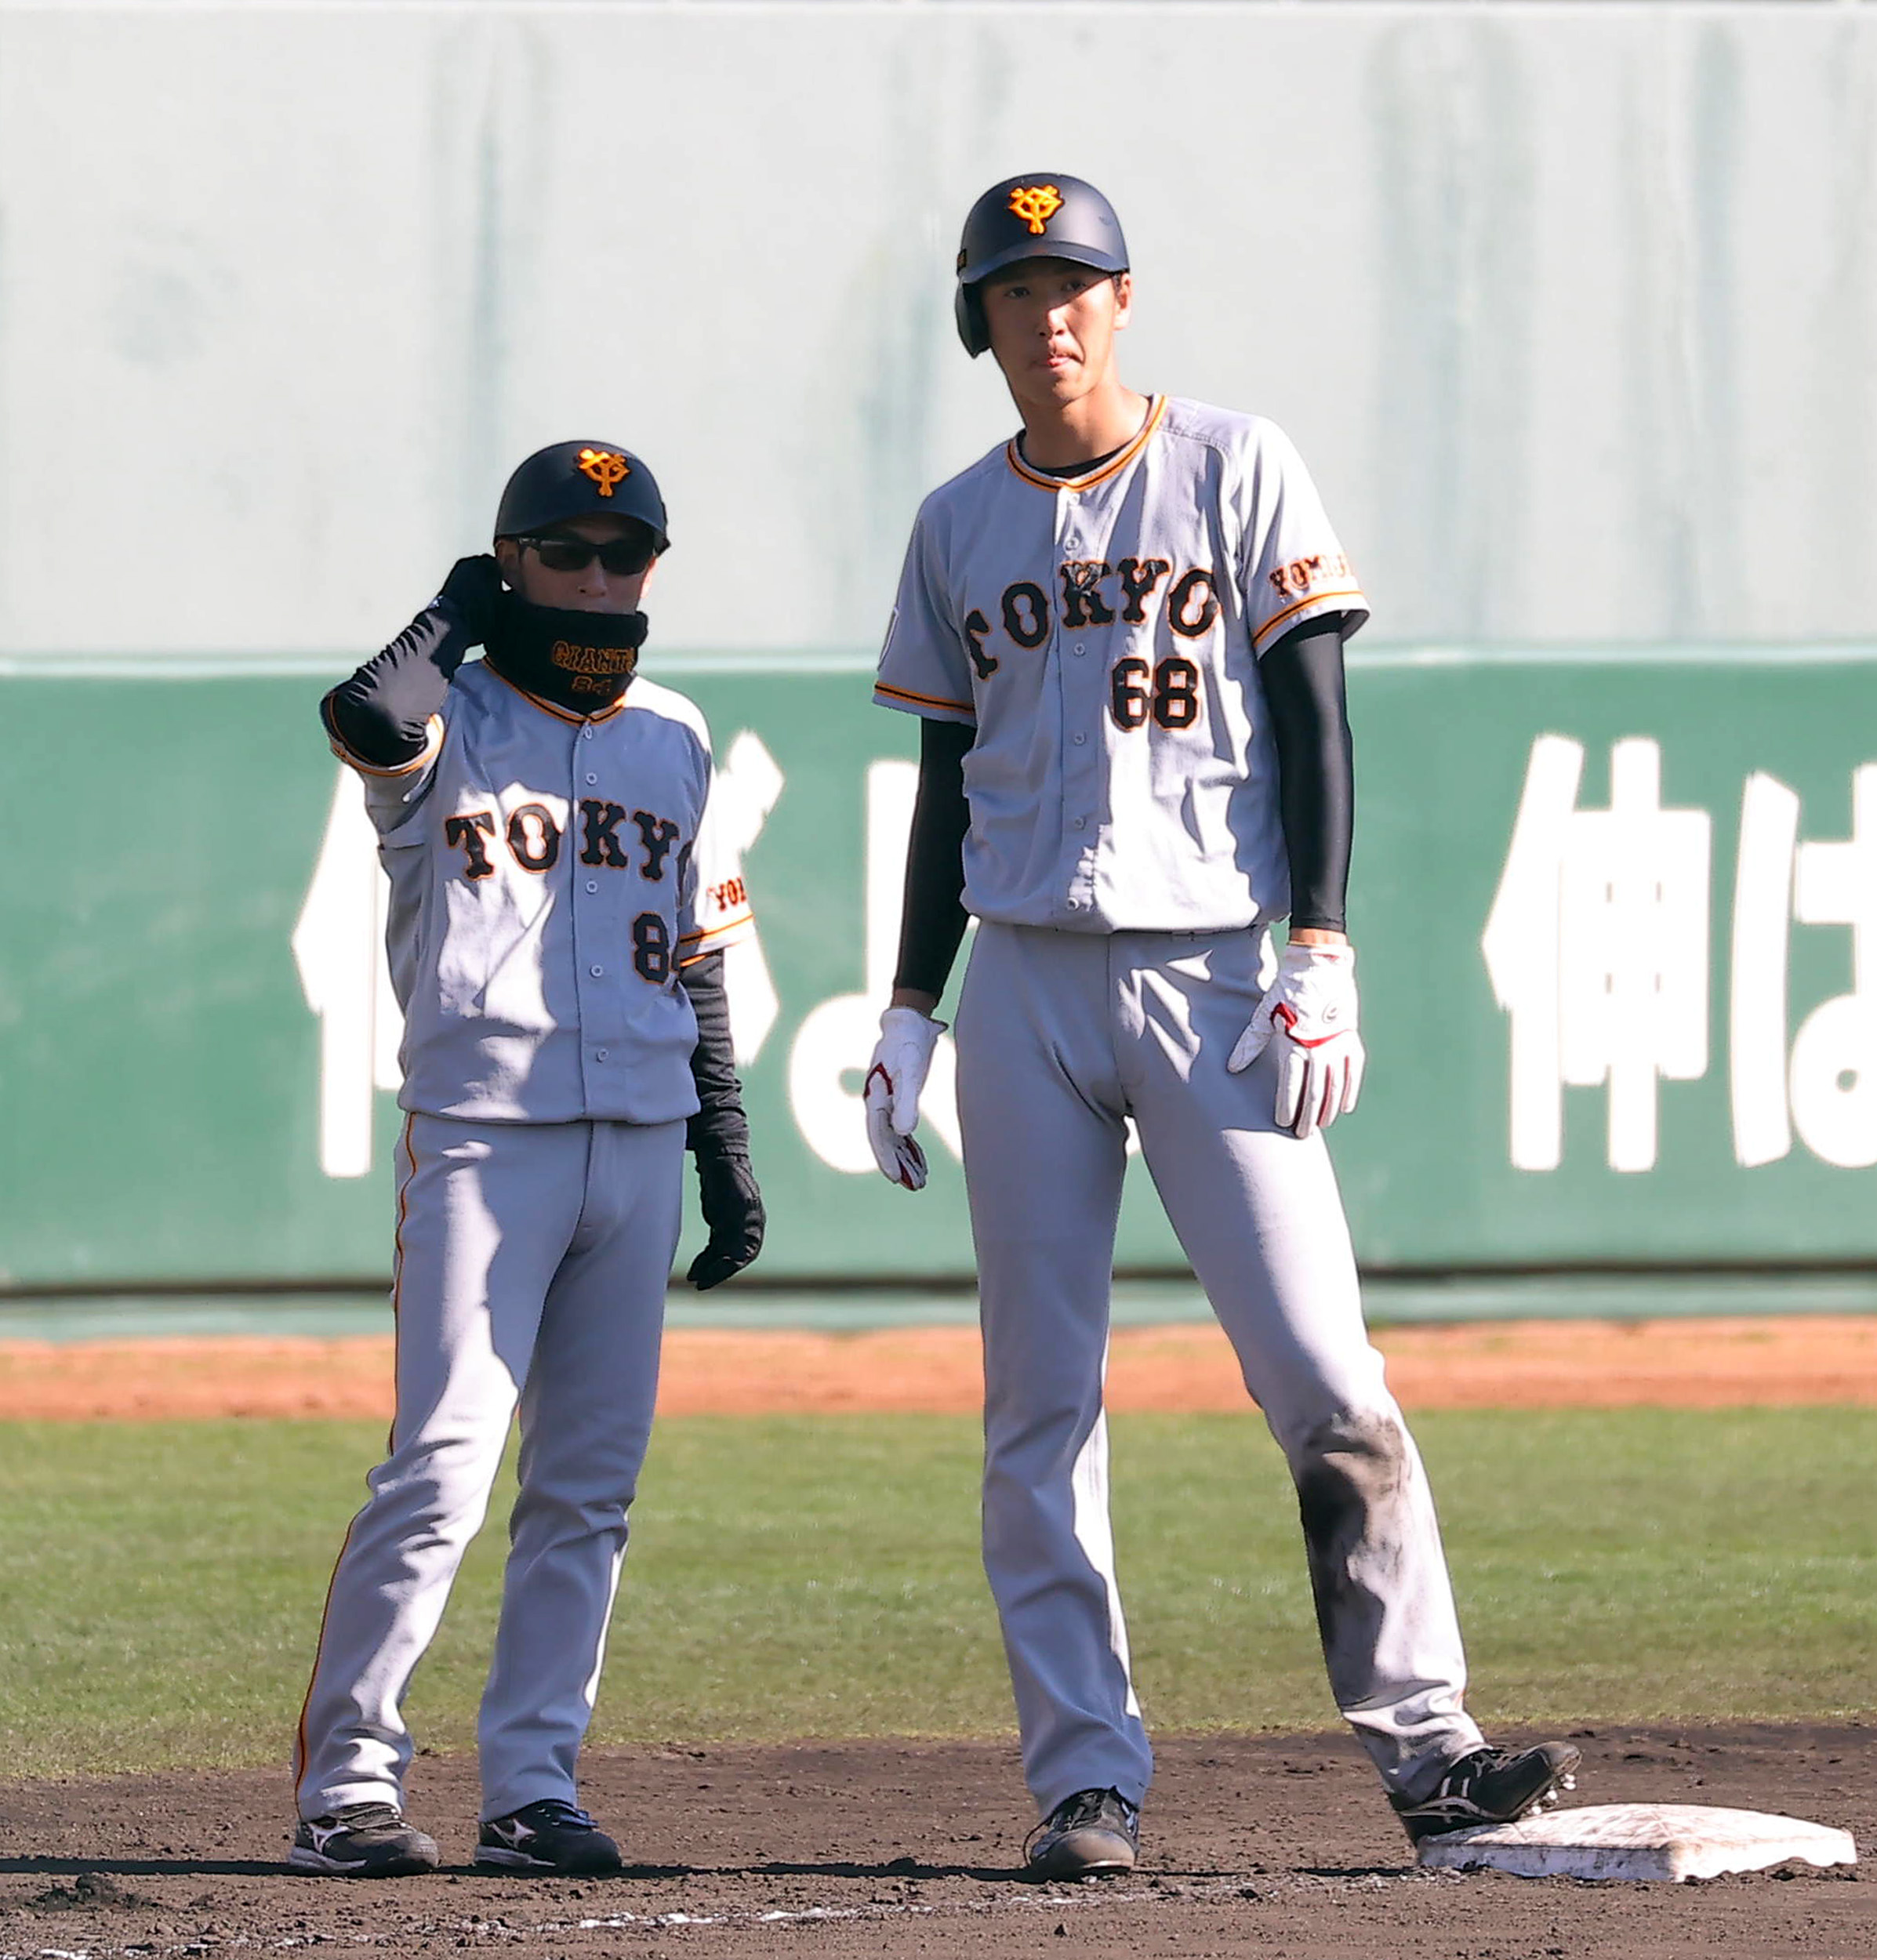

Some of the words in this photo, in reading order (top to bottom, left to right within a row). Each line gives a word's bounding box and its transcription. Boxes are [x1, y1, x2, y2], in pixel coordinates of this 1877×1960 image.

[1110, 657, 1199, 732] 68
[445, 796, 693, 908] TOKY
[632, 911, 680, 993] 8
